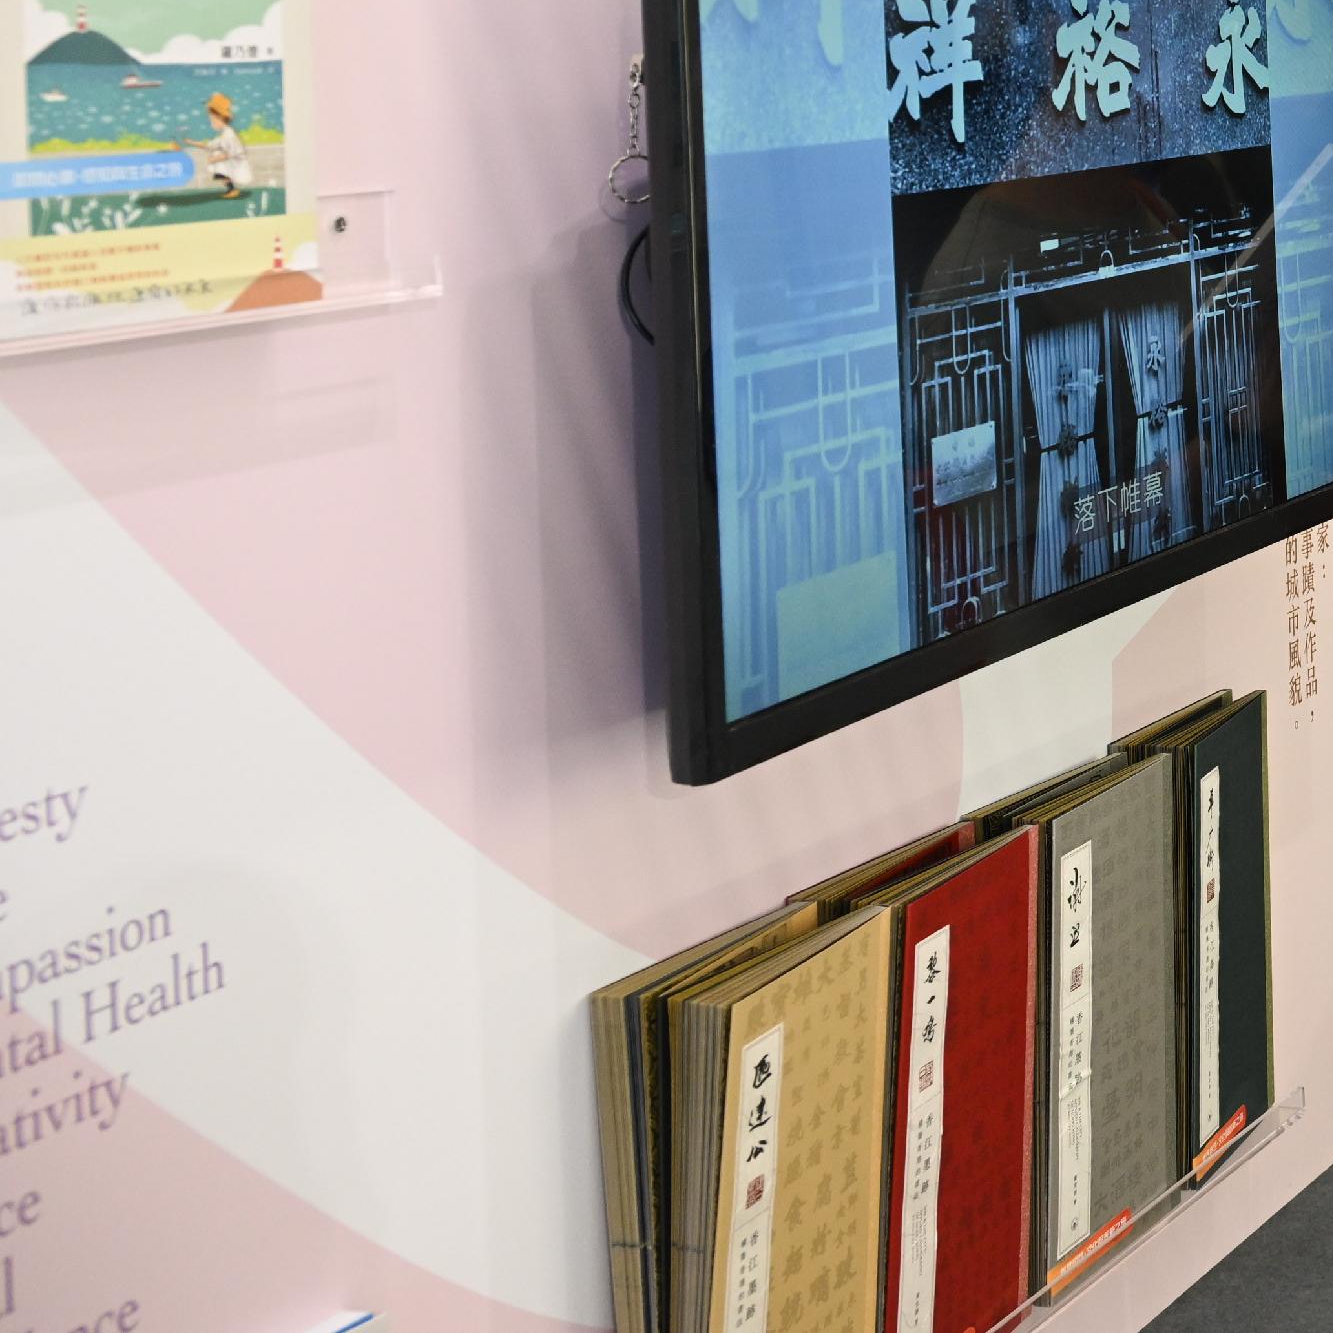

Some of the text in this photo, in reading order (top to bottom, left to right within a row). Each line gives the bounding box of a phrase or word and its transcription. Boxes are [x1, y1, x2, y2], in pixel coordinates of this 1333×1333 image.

[1073, 471, 1163, 536] 落下帷幕
[0, 904, 172, 1016] passion
[80, 940, 226, 1046] Health
